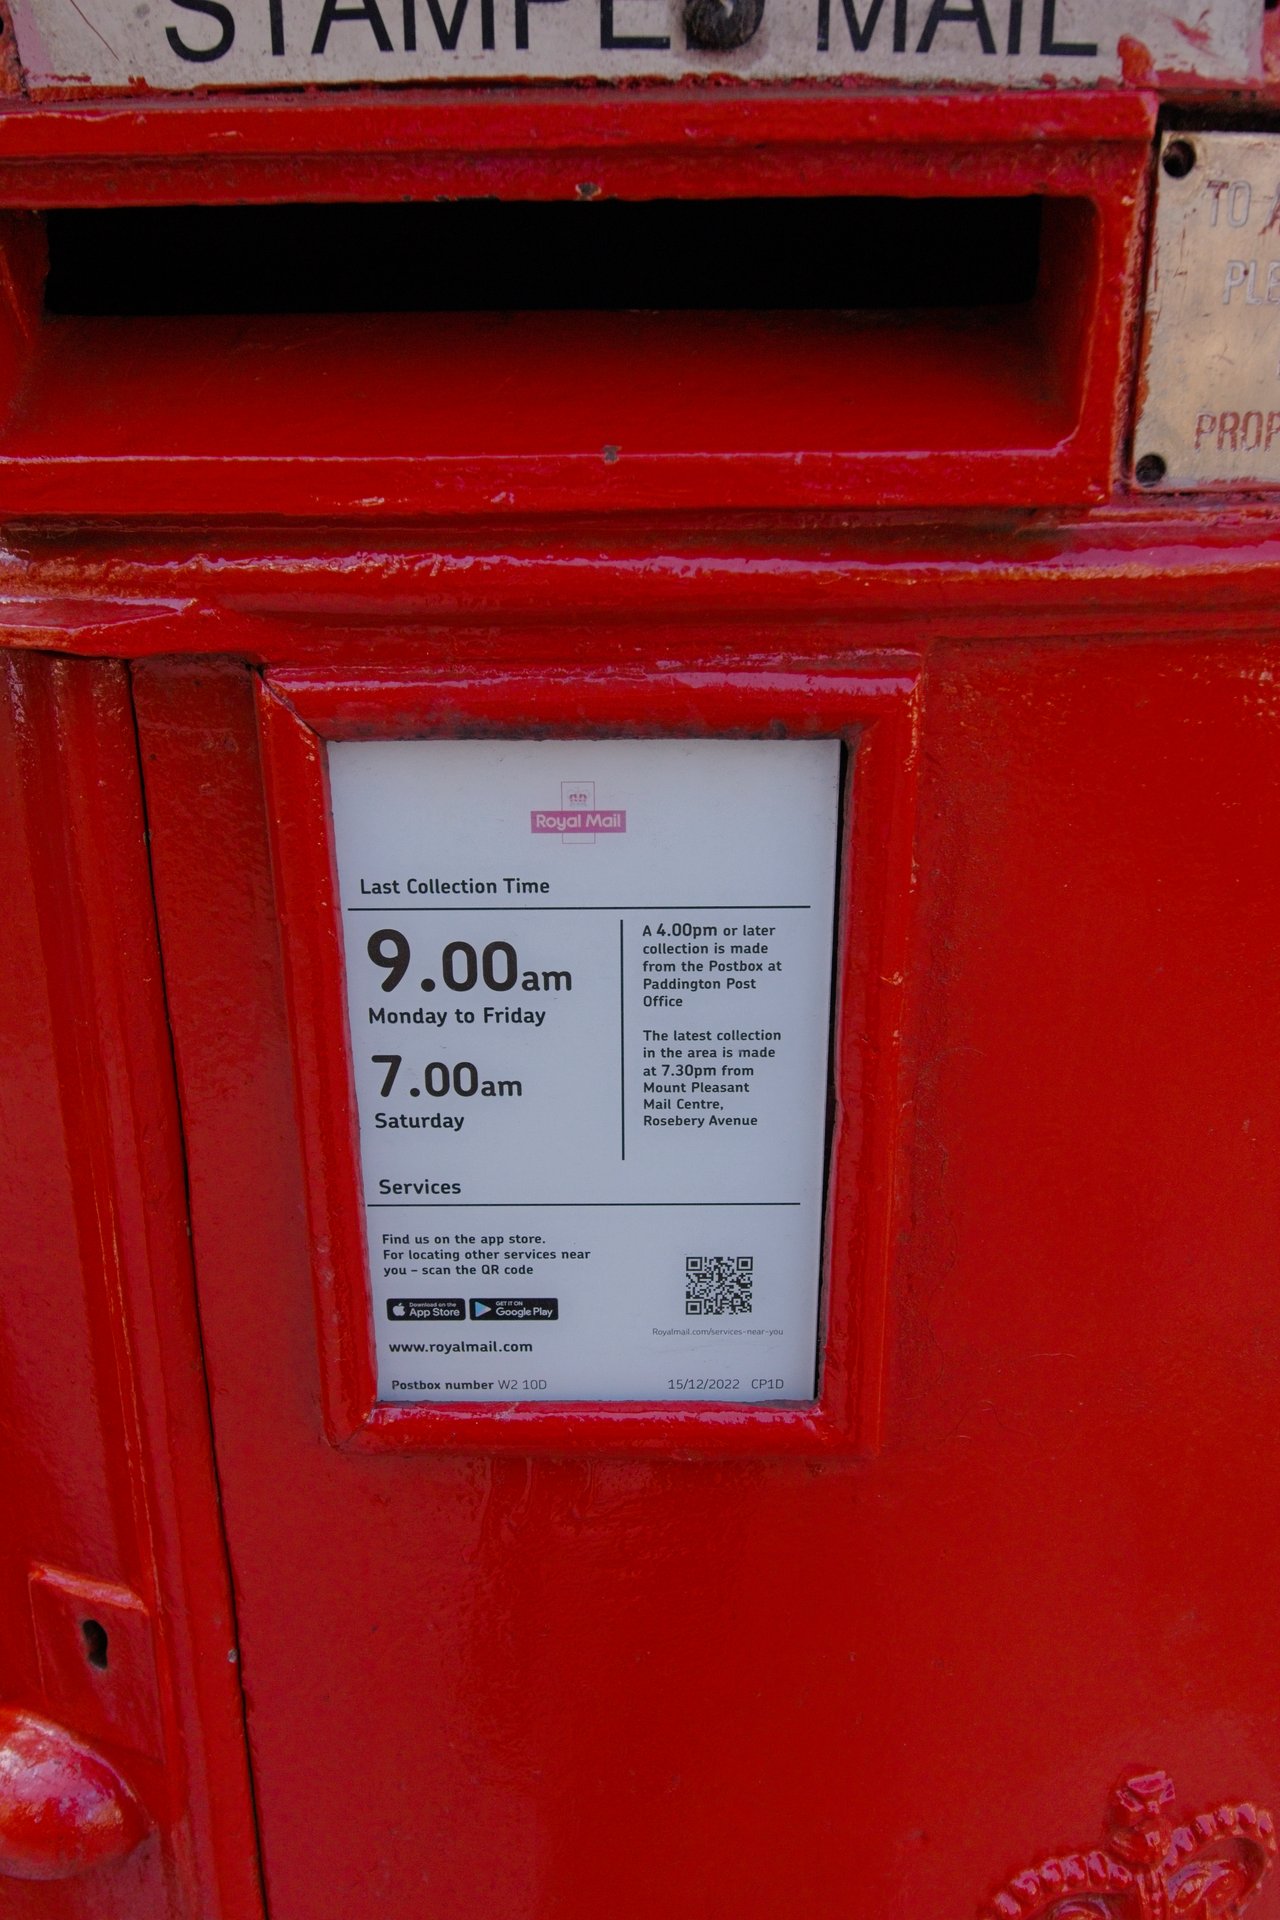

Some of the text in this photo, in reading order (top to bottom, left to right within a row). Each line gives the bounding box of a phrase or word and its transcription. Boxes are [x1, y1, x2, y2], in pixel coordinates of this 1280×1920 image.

[816, 0, 1099, 57] MAIL
[1206, 180, 1252, 228] TO
[535, 813, 622, 831] Royal Mail
[360, 877, 550, 895] Last Collection Time
[642, 922, 776, 940] A 4.00pm or later
[642, 942, 769, 955] collection is made
[367, 928, 572, 993] 9.00am
[642, 959, 783, 973] from the Postbox at
[643, 977, 757, 993] Paddington Post
[643, 995, 683, 1008] Office
[368, 1006, 546, 1028] Monday to Friday
[642, 1029, 782, 1042] The latest collection
[643, 1046, 776, 1059] in the area is made
[371, 1054, 523, 1098] 7.00am
[642, 1063, 754, 1079] at 7.30pm from
[643, 1081, 750, 1093] Mount Pleasant
[643, 1098, 724, 1111] Mail Centre,
[374, 1112, 465, 1132] Saturday
[643, 1114, 758, 1129] Rosebery Avenue
[378, 1178, 462, 1195] Services
[382, 1233, 546, 1247] Find us on the app store.
[383, 1248, 591, 1262] For locating other services near
[383, 1267, 407, 1278] you
[421, 1267, 451, 1275] scan
[455, 1264, 477, 1275] the
[481, 1264, 500, 1275] QR
[504, 1264, 534, 1275] code
[409, 1307, 460, 1318] App Store
[495, 1306, 553, 1318] Google Play
[652, 1327, 784, 1337] Royalmail.com/services-near-you
[388, 1340, 533, 1355] www.royalmail.com
[391, 1380, 441, 1390] Postbox
[444, 1379, 495, 1390] number
[497, 1379, 518, 1390] W2
[668, 1378, 784, 1390] 15/12/2022 CP1D
